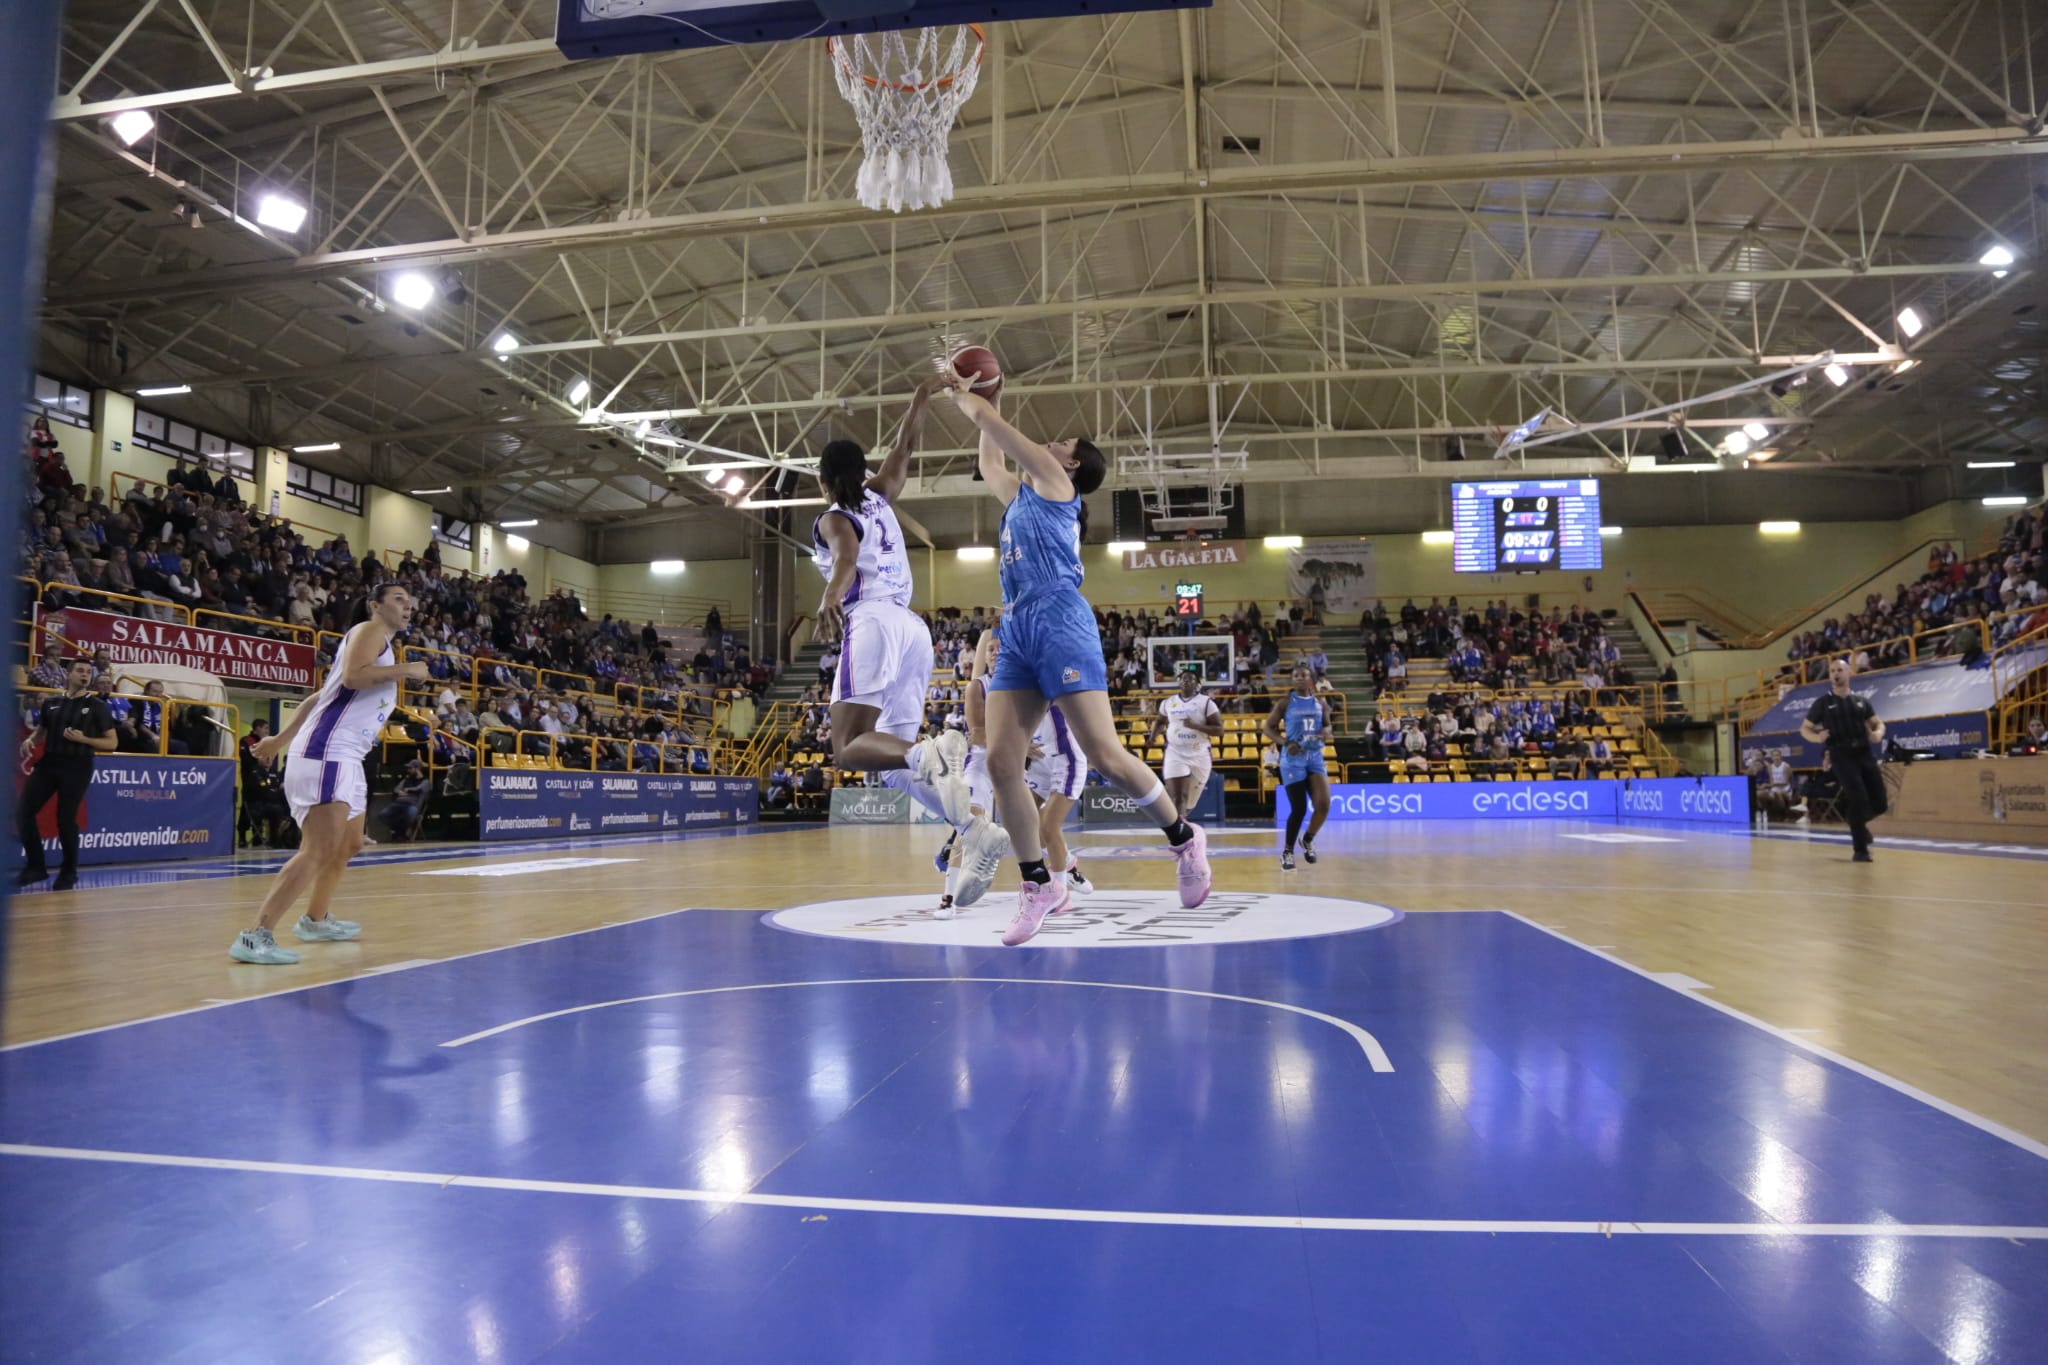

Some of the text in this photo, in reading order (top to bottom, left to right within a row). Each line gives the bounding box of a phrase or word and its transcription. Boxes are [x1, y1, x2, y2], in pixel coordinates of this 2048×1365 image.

[1502, 496, 1549, 513] 0 0
[1504, 532, 1549, 548] 09:47
[1177, 585, 1202, 594] 09:47
[1179, 599, 1199, 614] 21
[112, 620, 290, 664] SALAMANCA
[210, 657, 228, 674] LA
[231, 660, 309, 684] HUMANIDAD
[1303, 719, 1316, 731] 12
[90, 766, 207, 788] ASTILLA Y LEÓN
[490, 775, 538, 790] SALAMANCA
[602, 778, 638, 791] SALAMANCA
[1308, 786, 1588, 813] ndesa endesa
[1624, 787, 1663, 811] endesa
[1681, 784, 1732, 814] endesa
